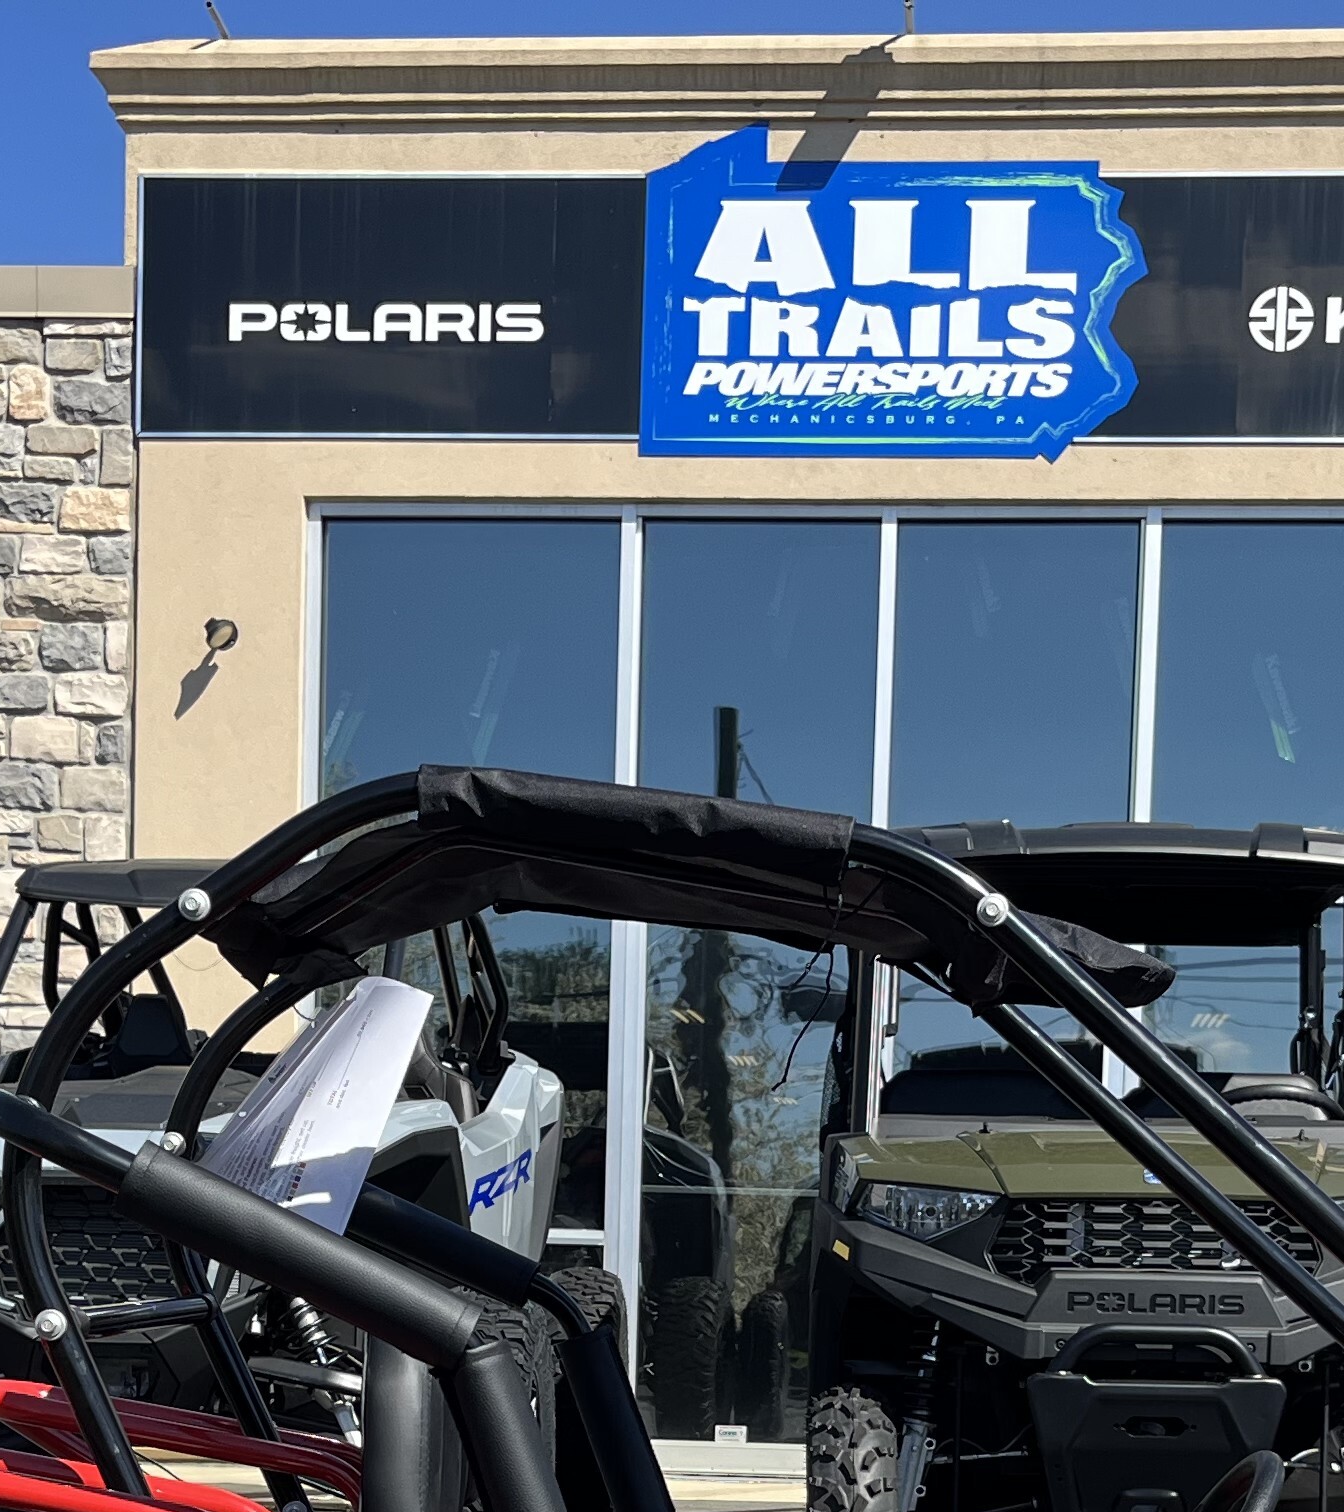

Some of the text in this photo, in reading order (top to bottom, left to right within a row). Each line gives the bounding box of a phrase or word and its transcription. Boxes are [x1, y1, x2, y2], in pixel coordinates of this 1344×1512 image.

[694, 199, 1078, 294] ALL
[228, 301, 545, 343] POLARIS
[682, 294, 1075, 363] TRAILS
[683, 361, 1073, 398] POWERSPORTS
[725, 392, 1008, 411] Where All Trails Meet
[996, 415, 1025, 425] PA
[469, 1147, 533, 1217] RZR
[1066, 1291, 1246, 1316] POLARIS
